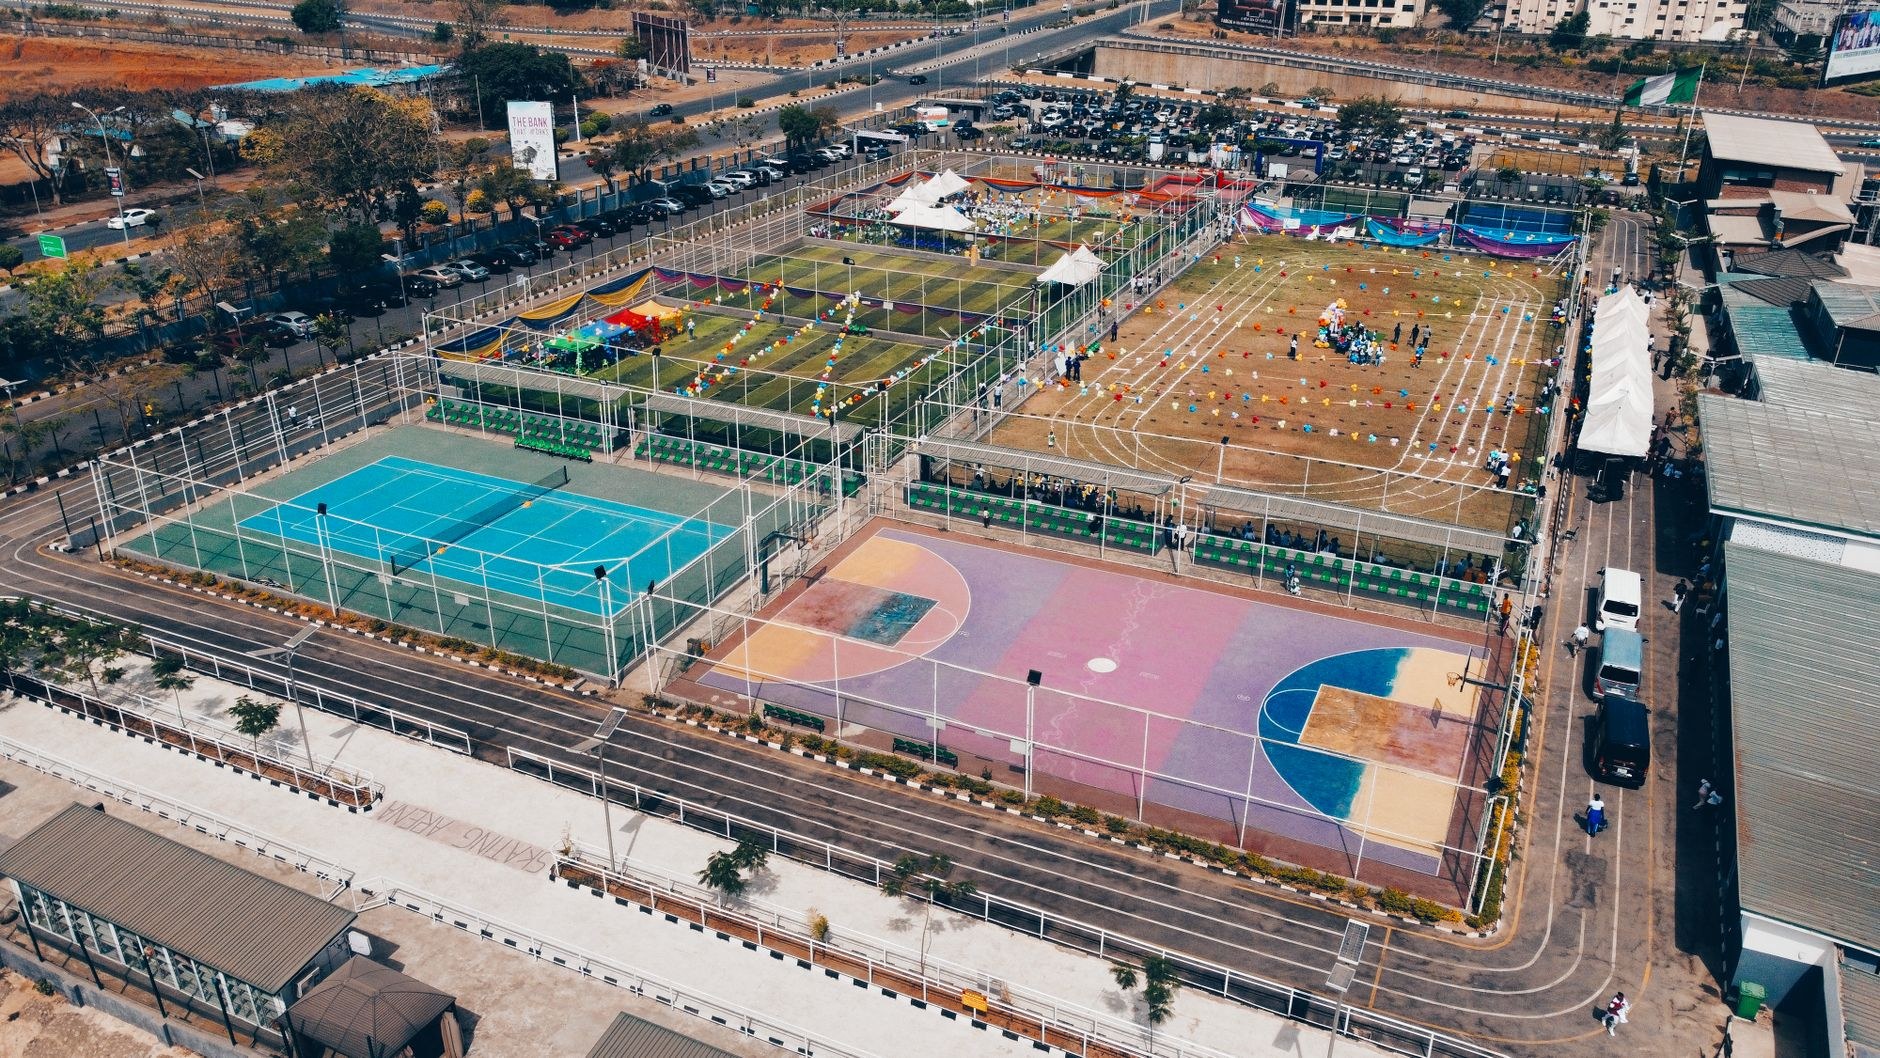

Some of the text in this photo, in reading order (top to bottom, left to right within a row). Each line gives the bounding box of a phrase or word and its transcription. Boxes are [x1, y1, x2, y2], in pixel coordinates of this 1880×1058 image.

[512, 117, 548, 128] THE BANK
[377, 800, 552, 873] SKATING ARENA
